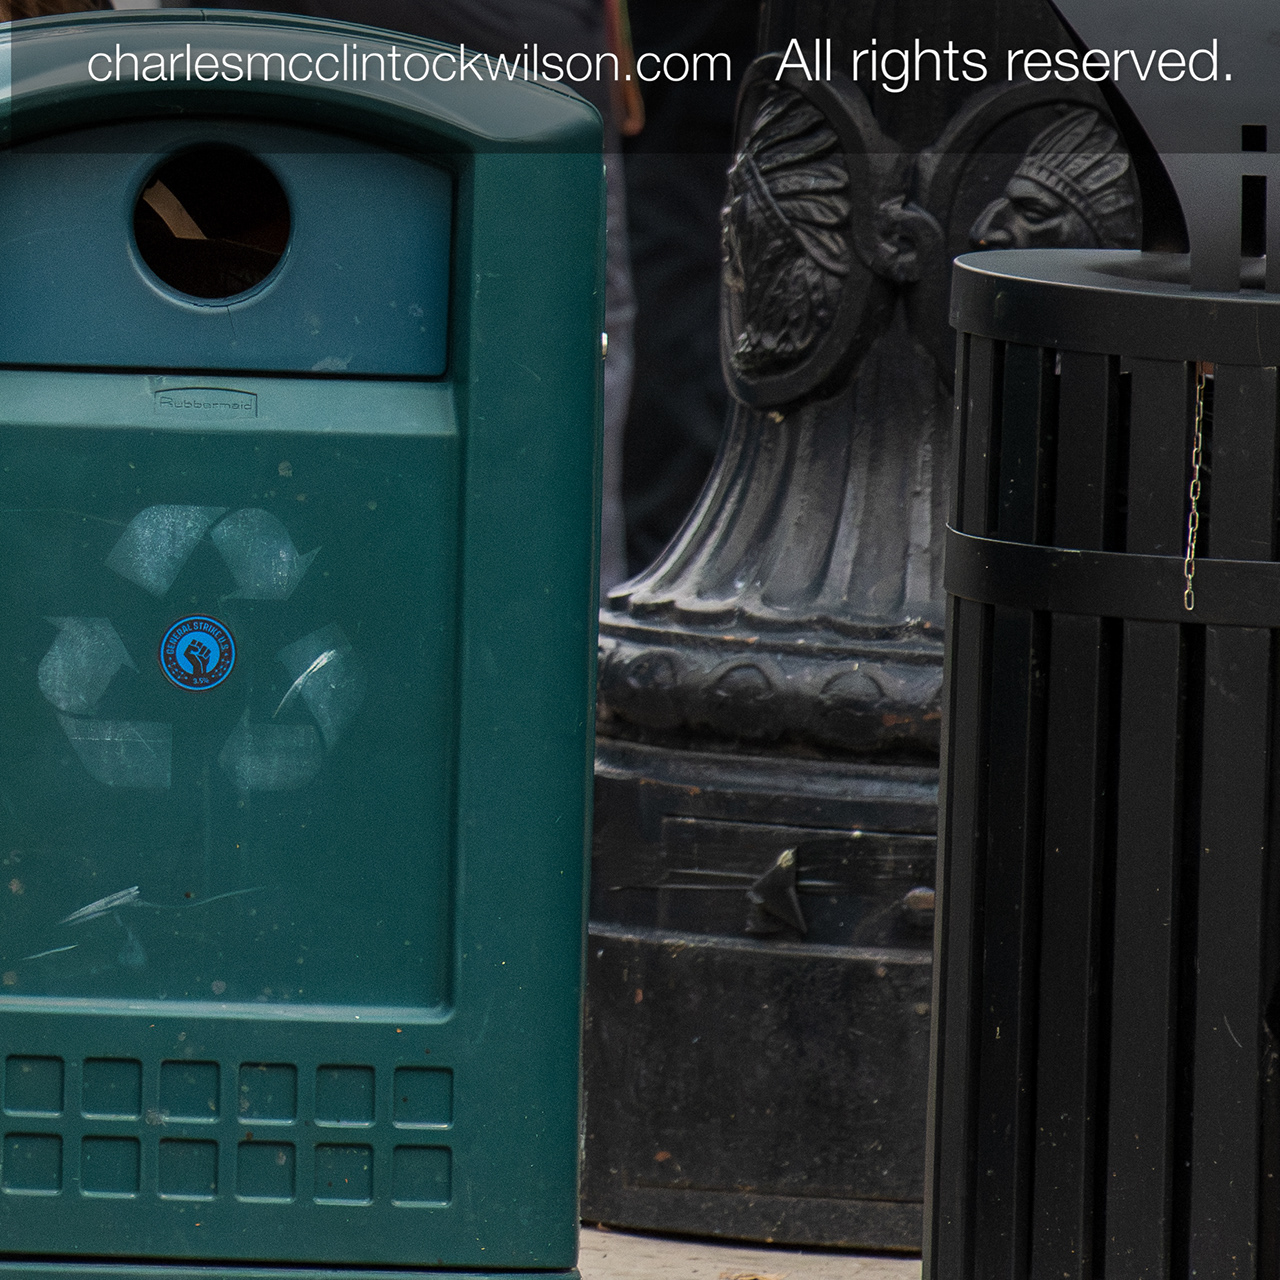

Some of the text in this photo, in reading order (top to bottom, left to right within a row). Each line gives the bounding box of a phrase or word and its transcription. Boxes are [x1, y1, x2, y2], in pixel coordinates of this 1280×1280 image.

[160, 396, 252, 410] Rubbermaid
[166, 623, 192, 654] GENERAL
[193, 621, 222, 638] STRIKE
